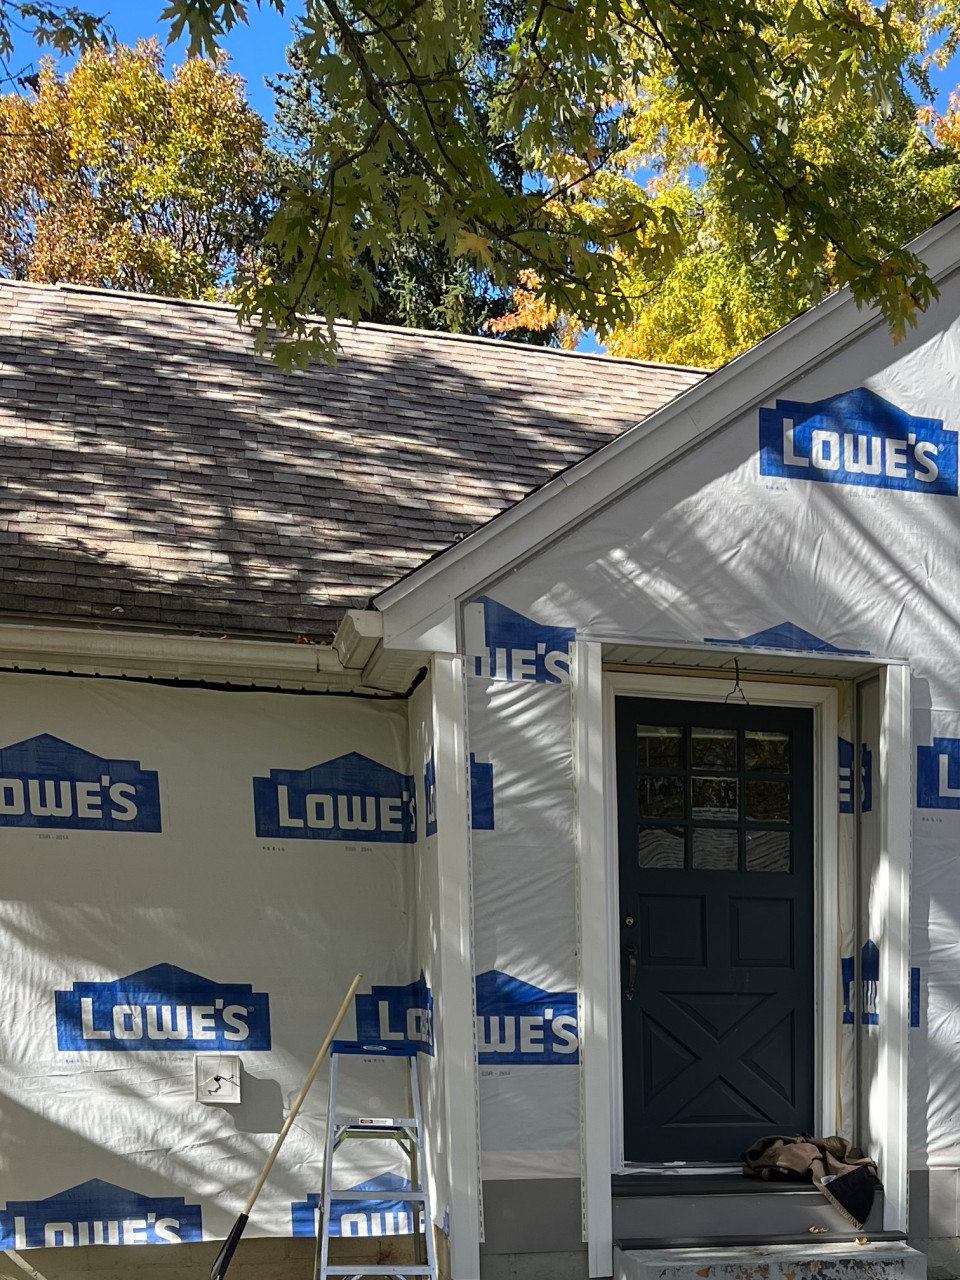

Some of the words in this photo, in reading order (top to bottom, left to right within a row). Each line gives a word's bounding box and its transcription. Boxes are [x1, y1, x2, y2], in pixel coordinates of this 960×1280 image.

[782, 417, 939, 483] LOWE'S
[0, 775, 138, 821] OWE'S
[81, 997, 250, 1041] LOWE'S
[14, 1212, 183, 1250] LOWE'S
